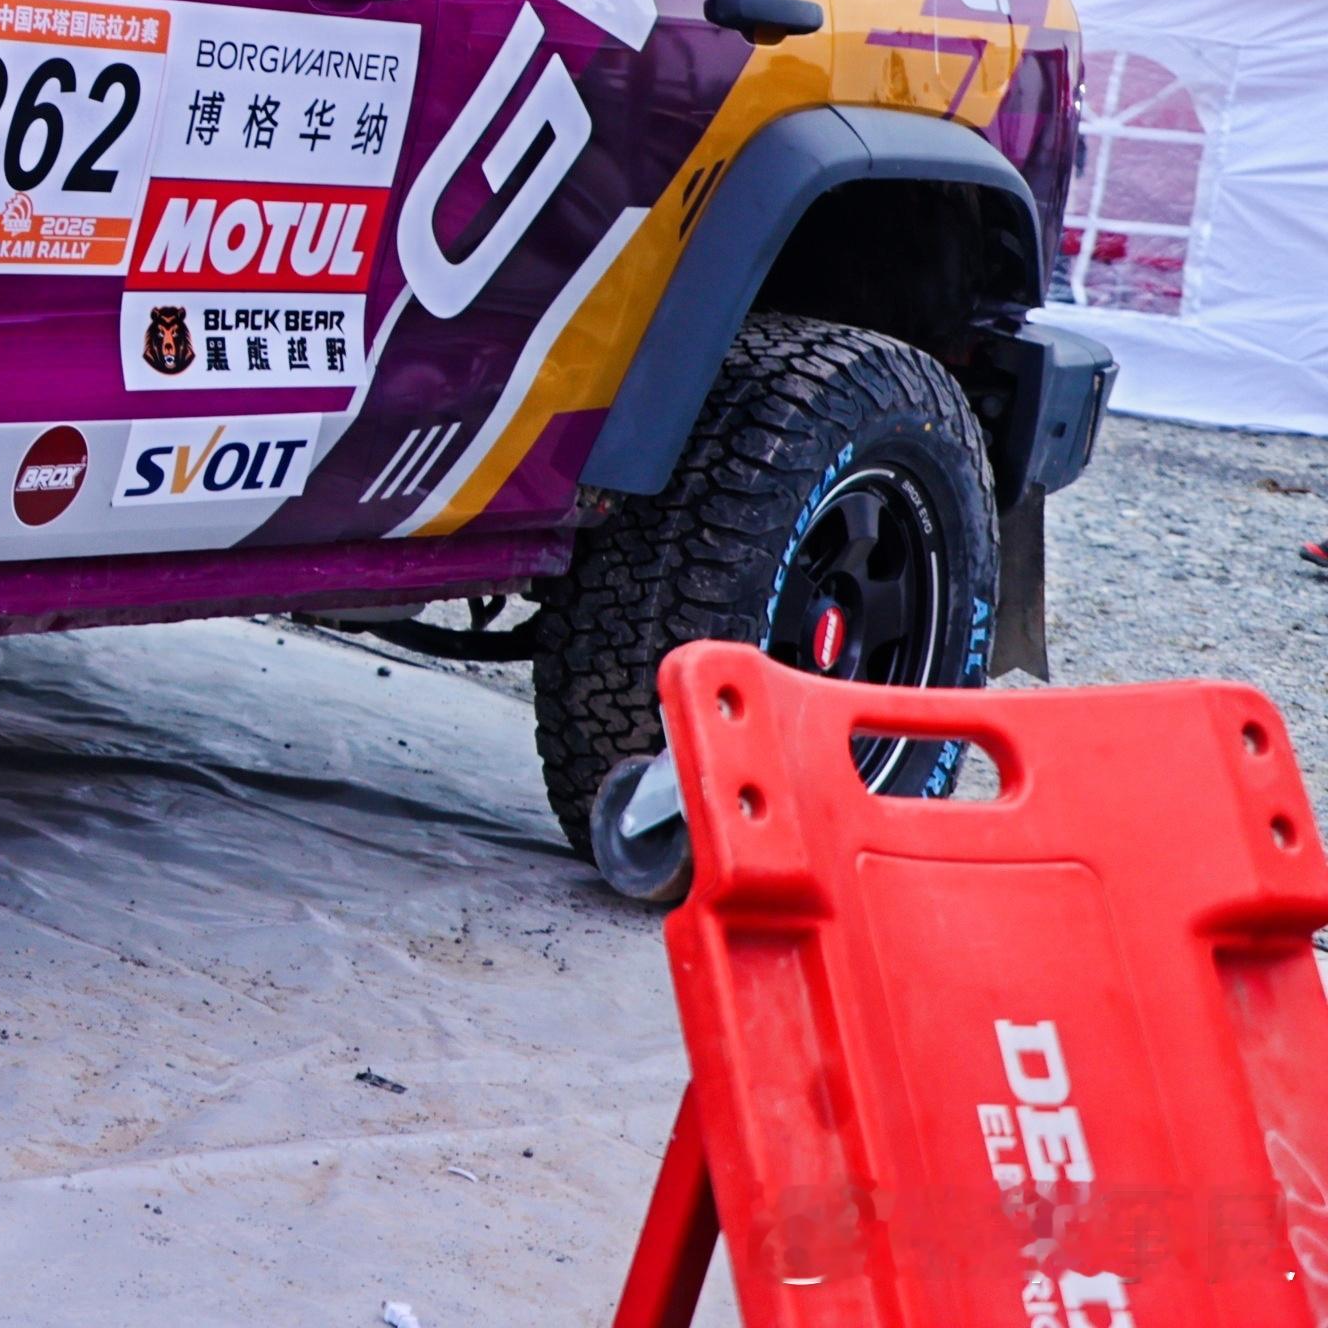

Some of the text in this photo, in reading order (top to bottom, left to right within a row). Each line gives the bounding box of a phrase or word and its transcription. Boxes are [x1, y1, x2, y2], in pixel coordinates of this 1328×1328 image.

[197, 39, 400, 84] BORGWARNER
[186, 89, 389, 156] 博格华纳
[39, 217, 97, 237] 2026
[140, 197, 367, 277] MOTUL
[36, 241, 92, 260] RALLY
[203, 308, 346, 334] BLACK BEAR
[205, 336, 347, 374] 黑熊越野
[15, 463, 83, 494] BROX
[123, 425, 309, 498] SVOLT
[900, 479, 932, 536] BROX EVO
